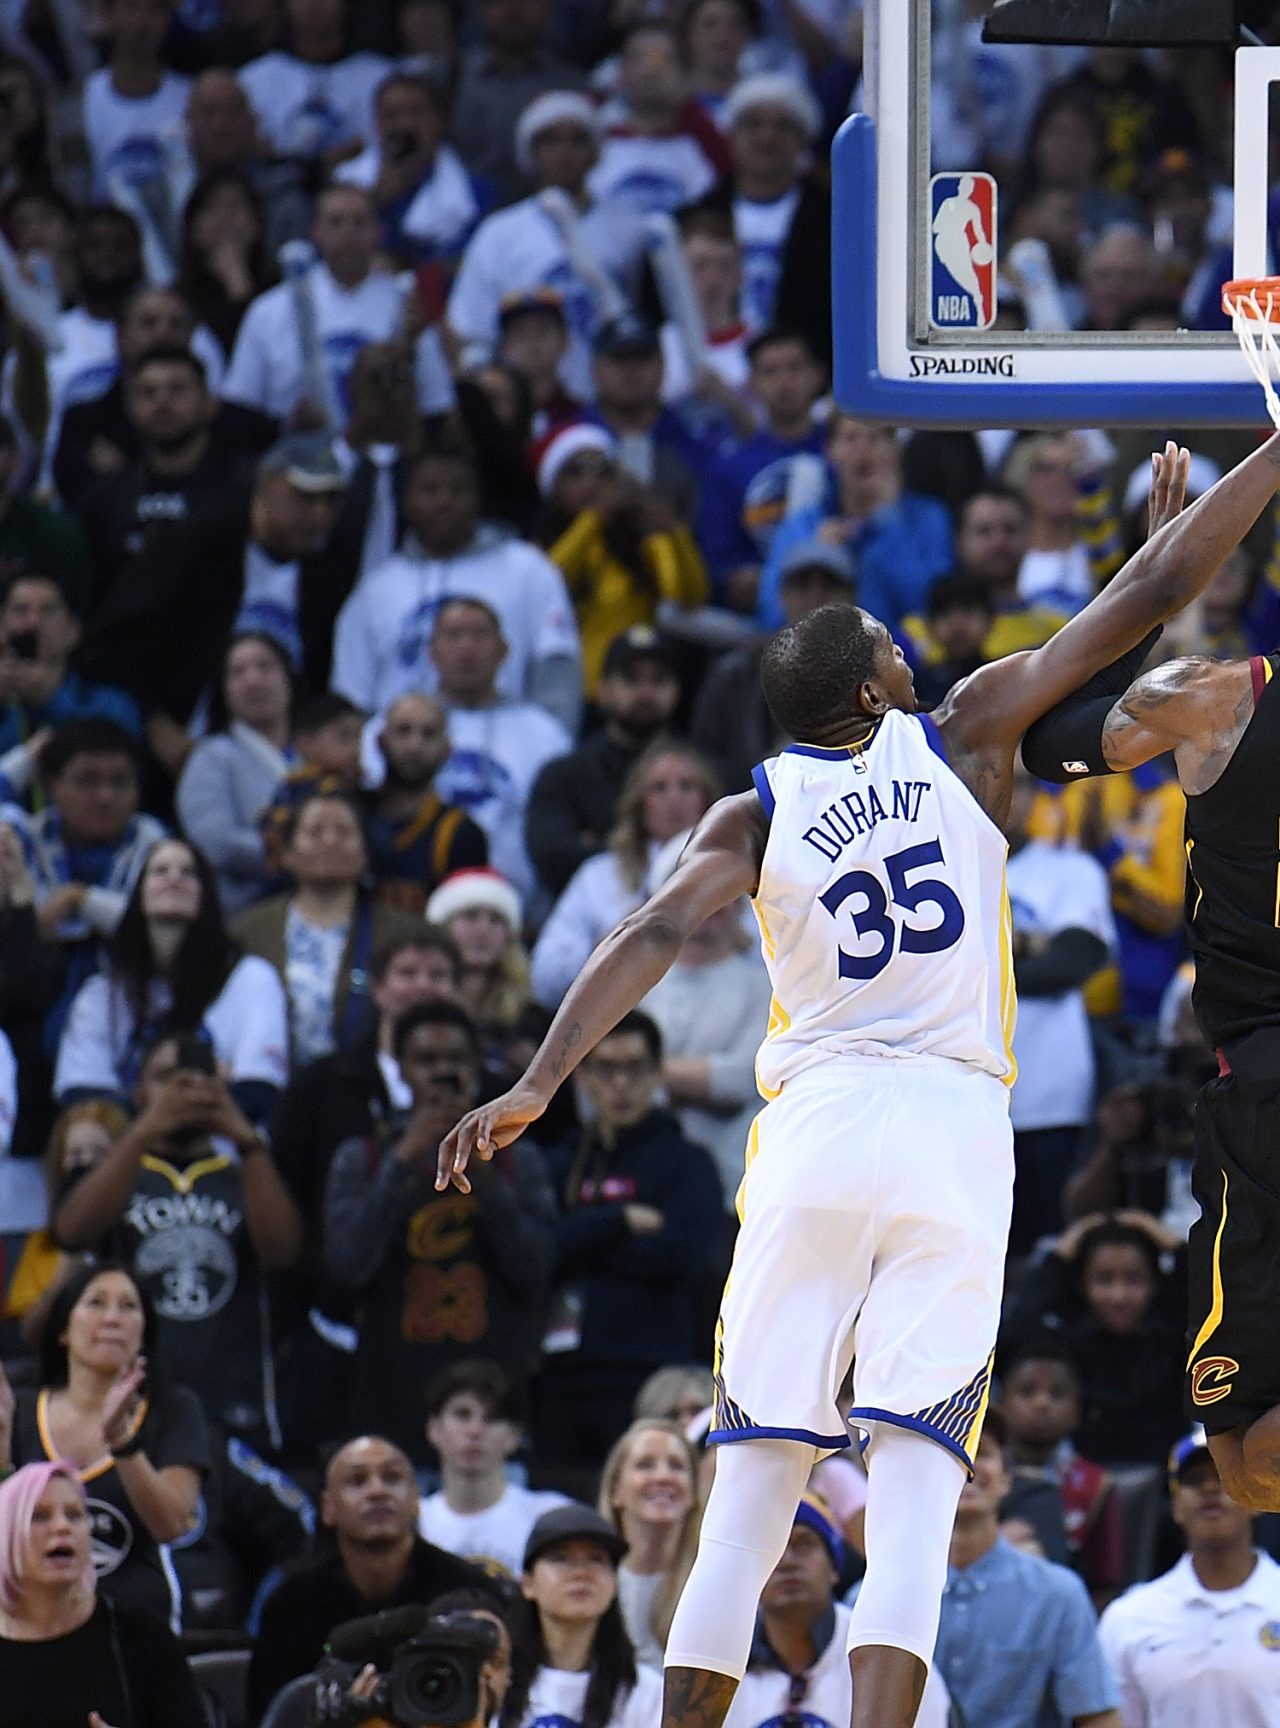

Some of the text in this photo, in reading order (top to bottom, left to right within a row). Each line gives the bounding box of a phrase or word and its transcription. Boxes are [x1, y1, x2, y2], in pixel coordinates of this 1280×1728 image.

[938, 295, 971, 321] NBA
[910, 354, 1016, 378] SPALDING
[802, 780, 931, 863] DURANT
[818, 835, 965, 980] 35
[127, 1193, 242, 1235] TOWN
[1192, 1356, 1240, 1406] C
